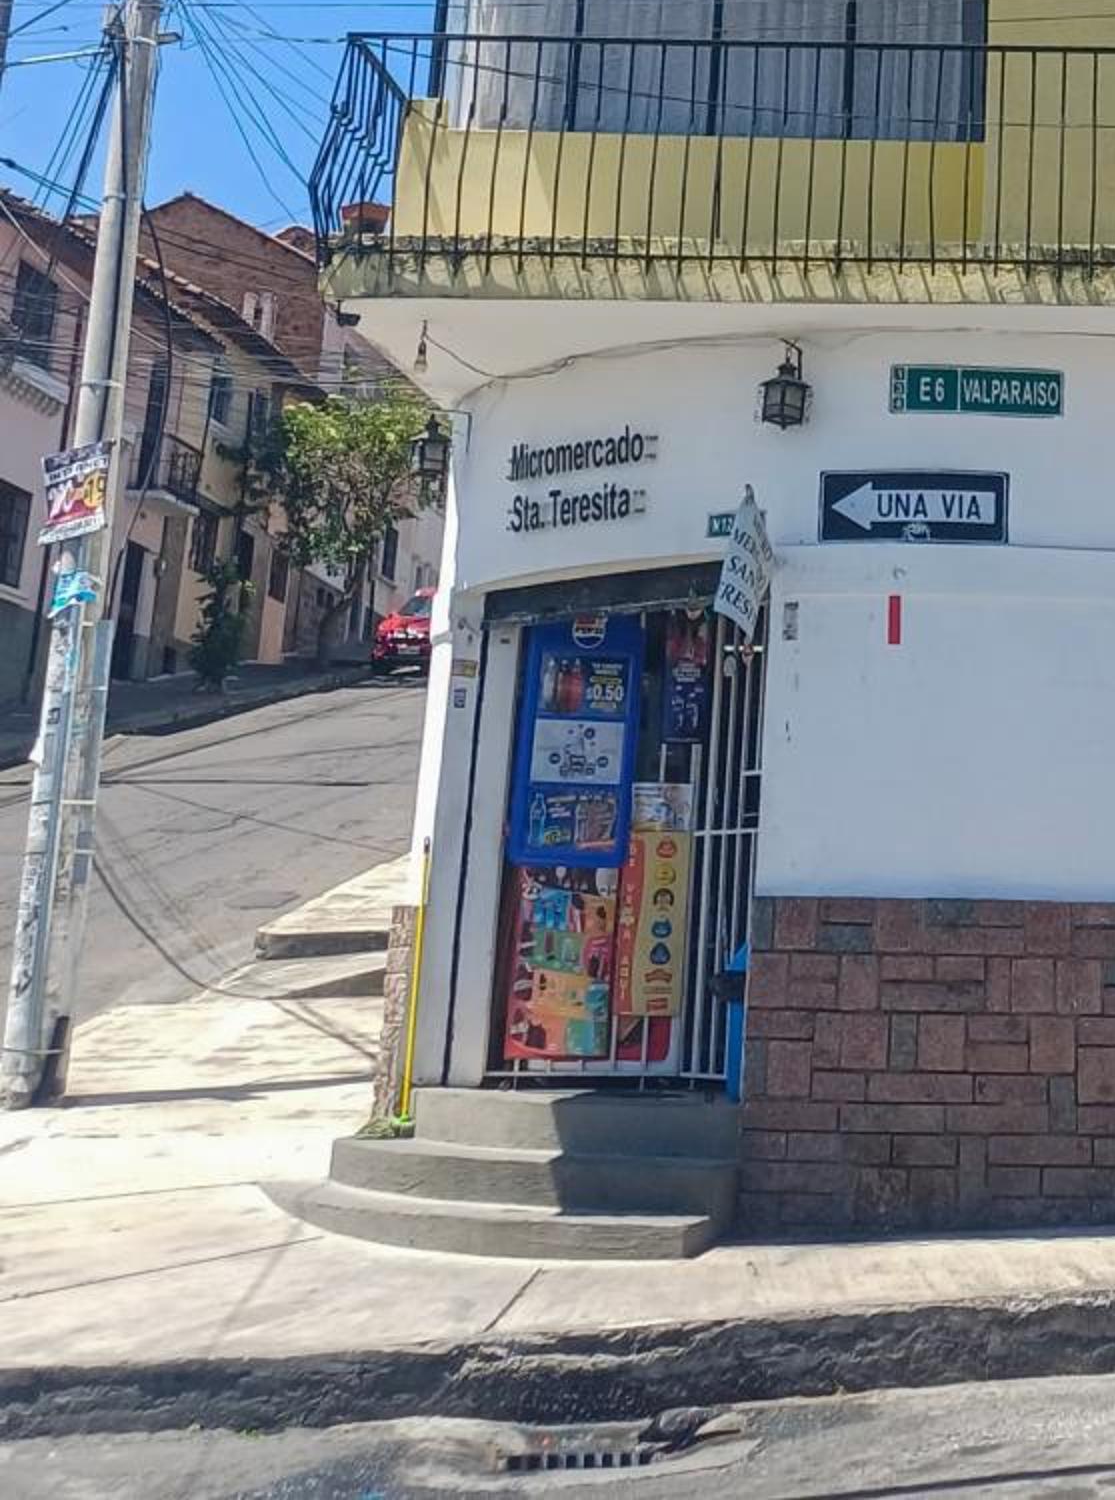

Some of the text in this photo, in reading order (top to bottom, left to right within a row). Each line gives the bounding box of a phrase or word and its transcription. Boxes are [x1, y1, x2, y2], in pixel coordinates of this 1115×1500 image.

[919, 377, 931, 402] E
[963, 379, 1059, 406] VALPARAISO
[510, 425, 644, 480] Micromercado
[510, 483, 631, 532] Sta. Teresita
[877, 493, 981, 520] UNA VIA
